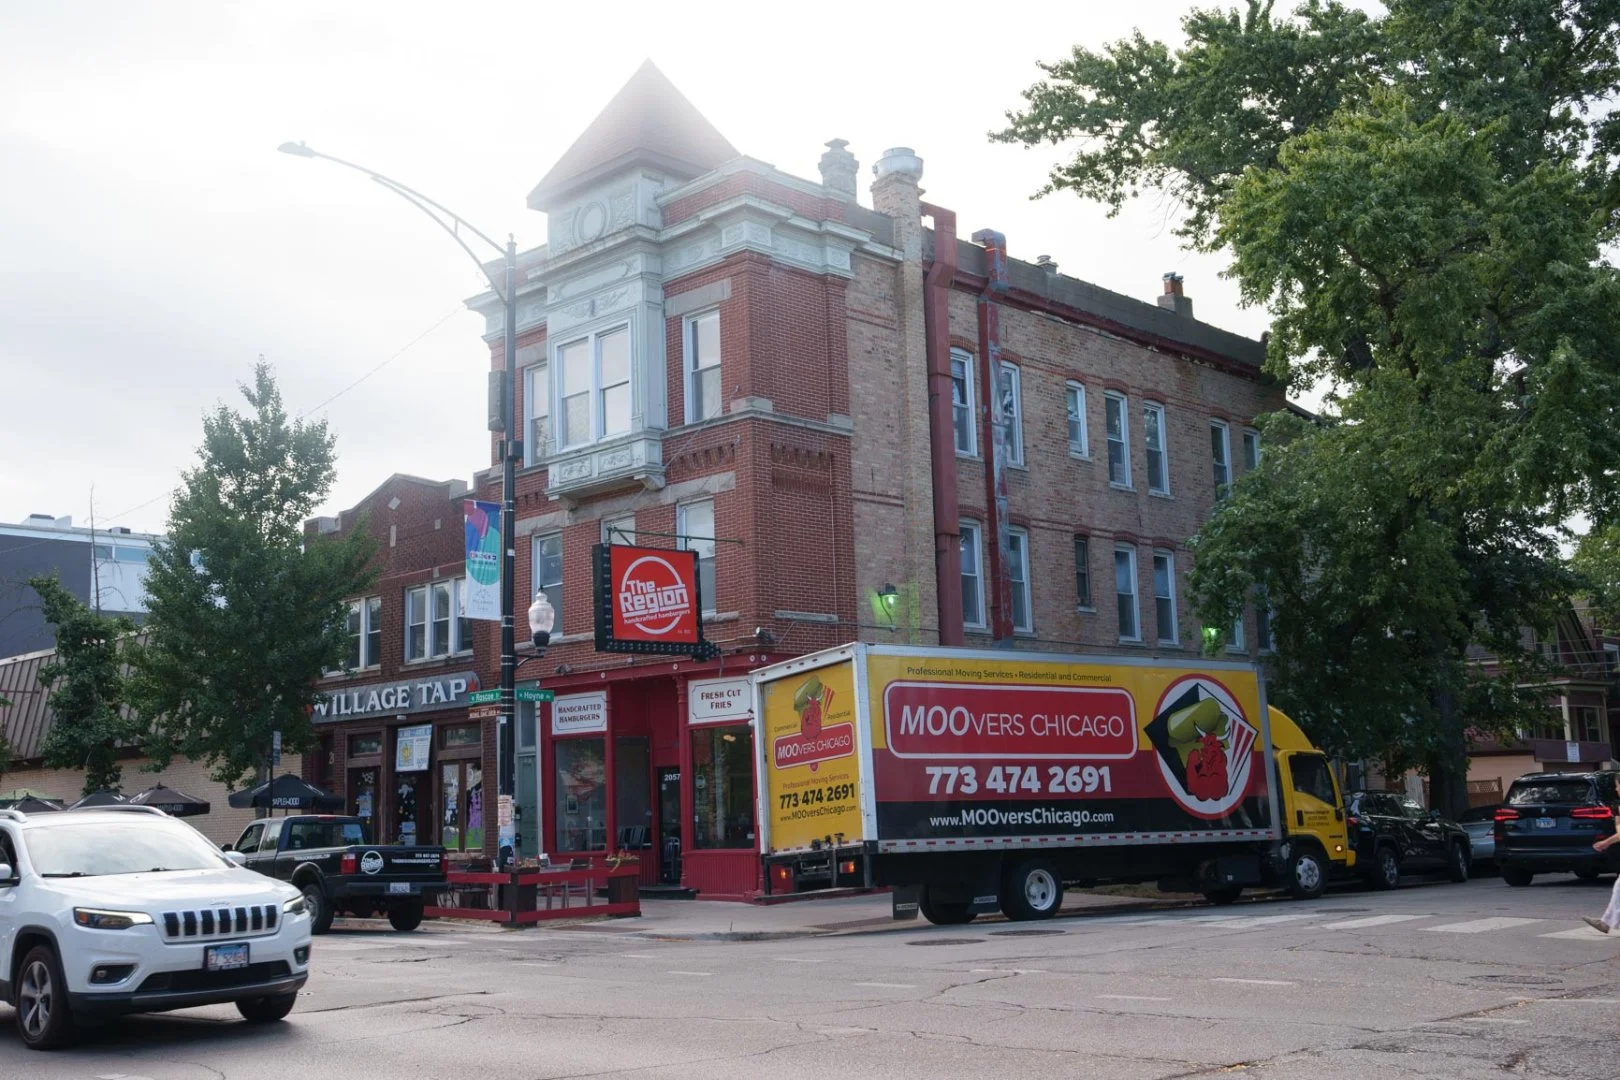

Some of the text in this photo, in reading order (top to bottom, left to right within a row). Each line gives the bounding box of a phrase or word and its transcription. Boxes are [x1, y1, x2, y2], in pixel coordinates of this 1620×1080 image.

[626, 579, 656, 595] The
[619, 587, 689, 614] Region
[906, 665, 1112, 683] Professional Moving Services Residential and Commercial
[416, 678, 467, 706] TAP
[476, 692, 494, 702] Roscoe
[523, 691, 544, 702] Hoyne
[701, 689, 742, 700] FRESH CUT
[558, 703, 602, 714] HANDCRAFTED
[710, 700, 732, 710] FRIES
[559, 713, 601, 724] HAMBURGERS
[899, 704, 1125, 738] MOOVERS CHICAGO
[777, 735, 851, 759] MOOVERS CHICAGO
[664, 773, 681, 782] 2057
[925, 765, 1112, 795] 773 474 2691
[780, 783, 855, 810] 773 474 2691
[780, 805, 857, 822] www.MOOversChicago.com
[930, 807, 1114, 828] www.MOOversChicago.com
